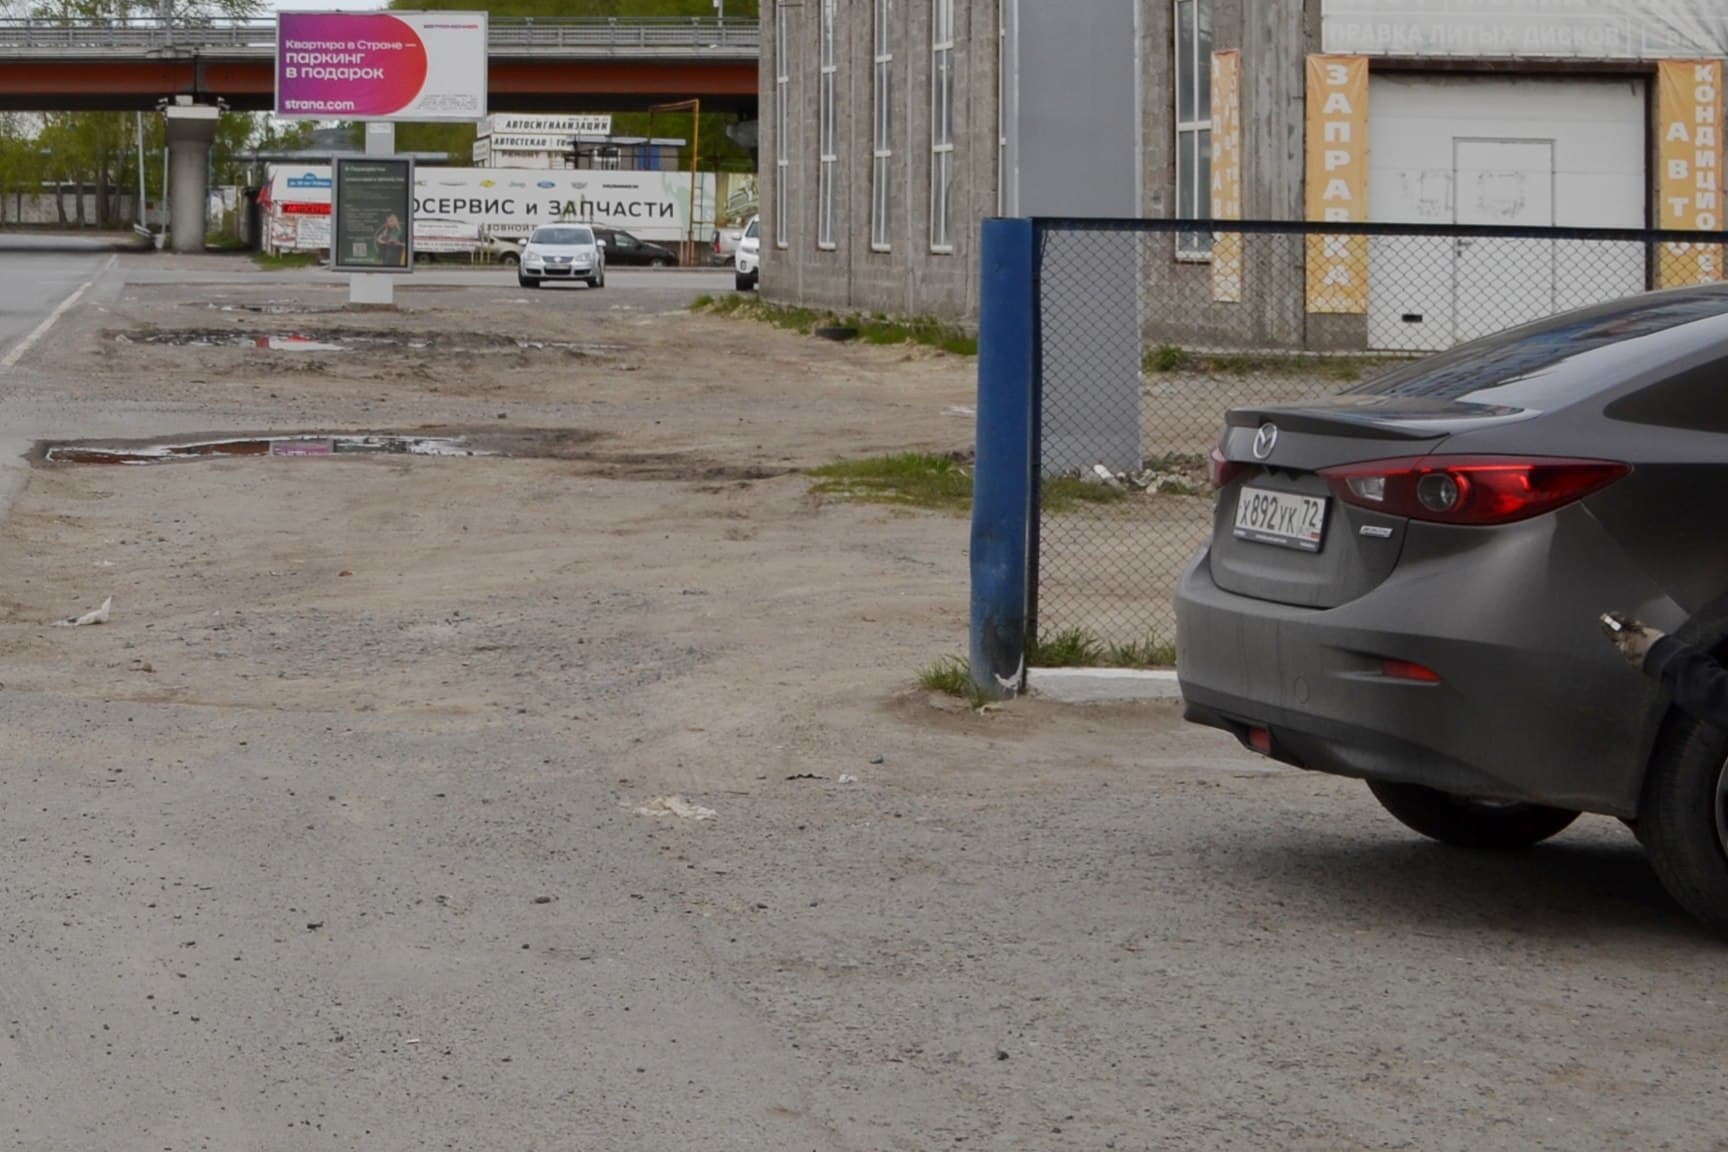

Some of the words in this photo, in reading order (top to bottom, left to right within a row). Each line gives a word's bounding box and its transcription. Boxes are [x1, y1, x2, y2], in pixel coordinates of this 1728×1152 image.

[285, 39, 345, 51] Квартира
[357, 39, 403, 51] Стране
[285, 52, 365, 66] паркинг
[285, 67, 298, 78] в
[301, 67, 385, 81] подарок
[285, 99, 355, 111] strana.com
[548, 200, 674, 218] ЗАПЧАСТИ
